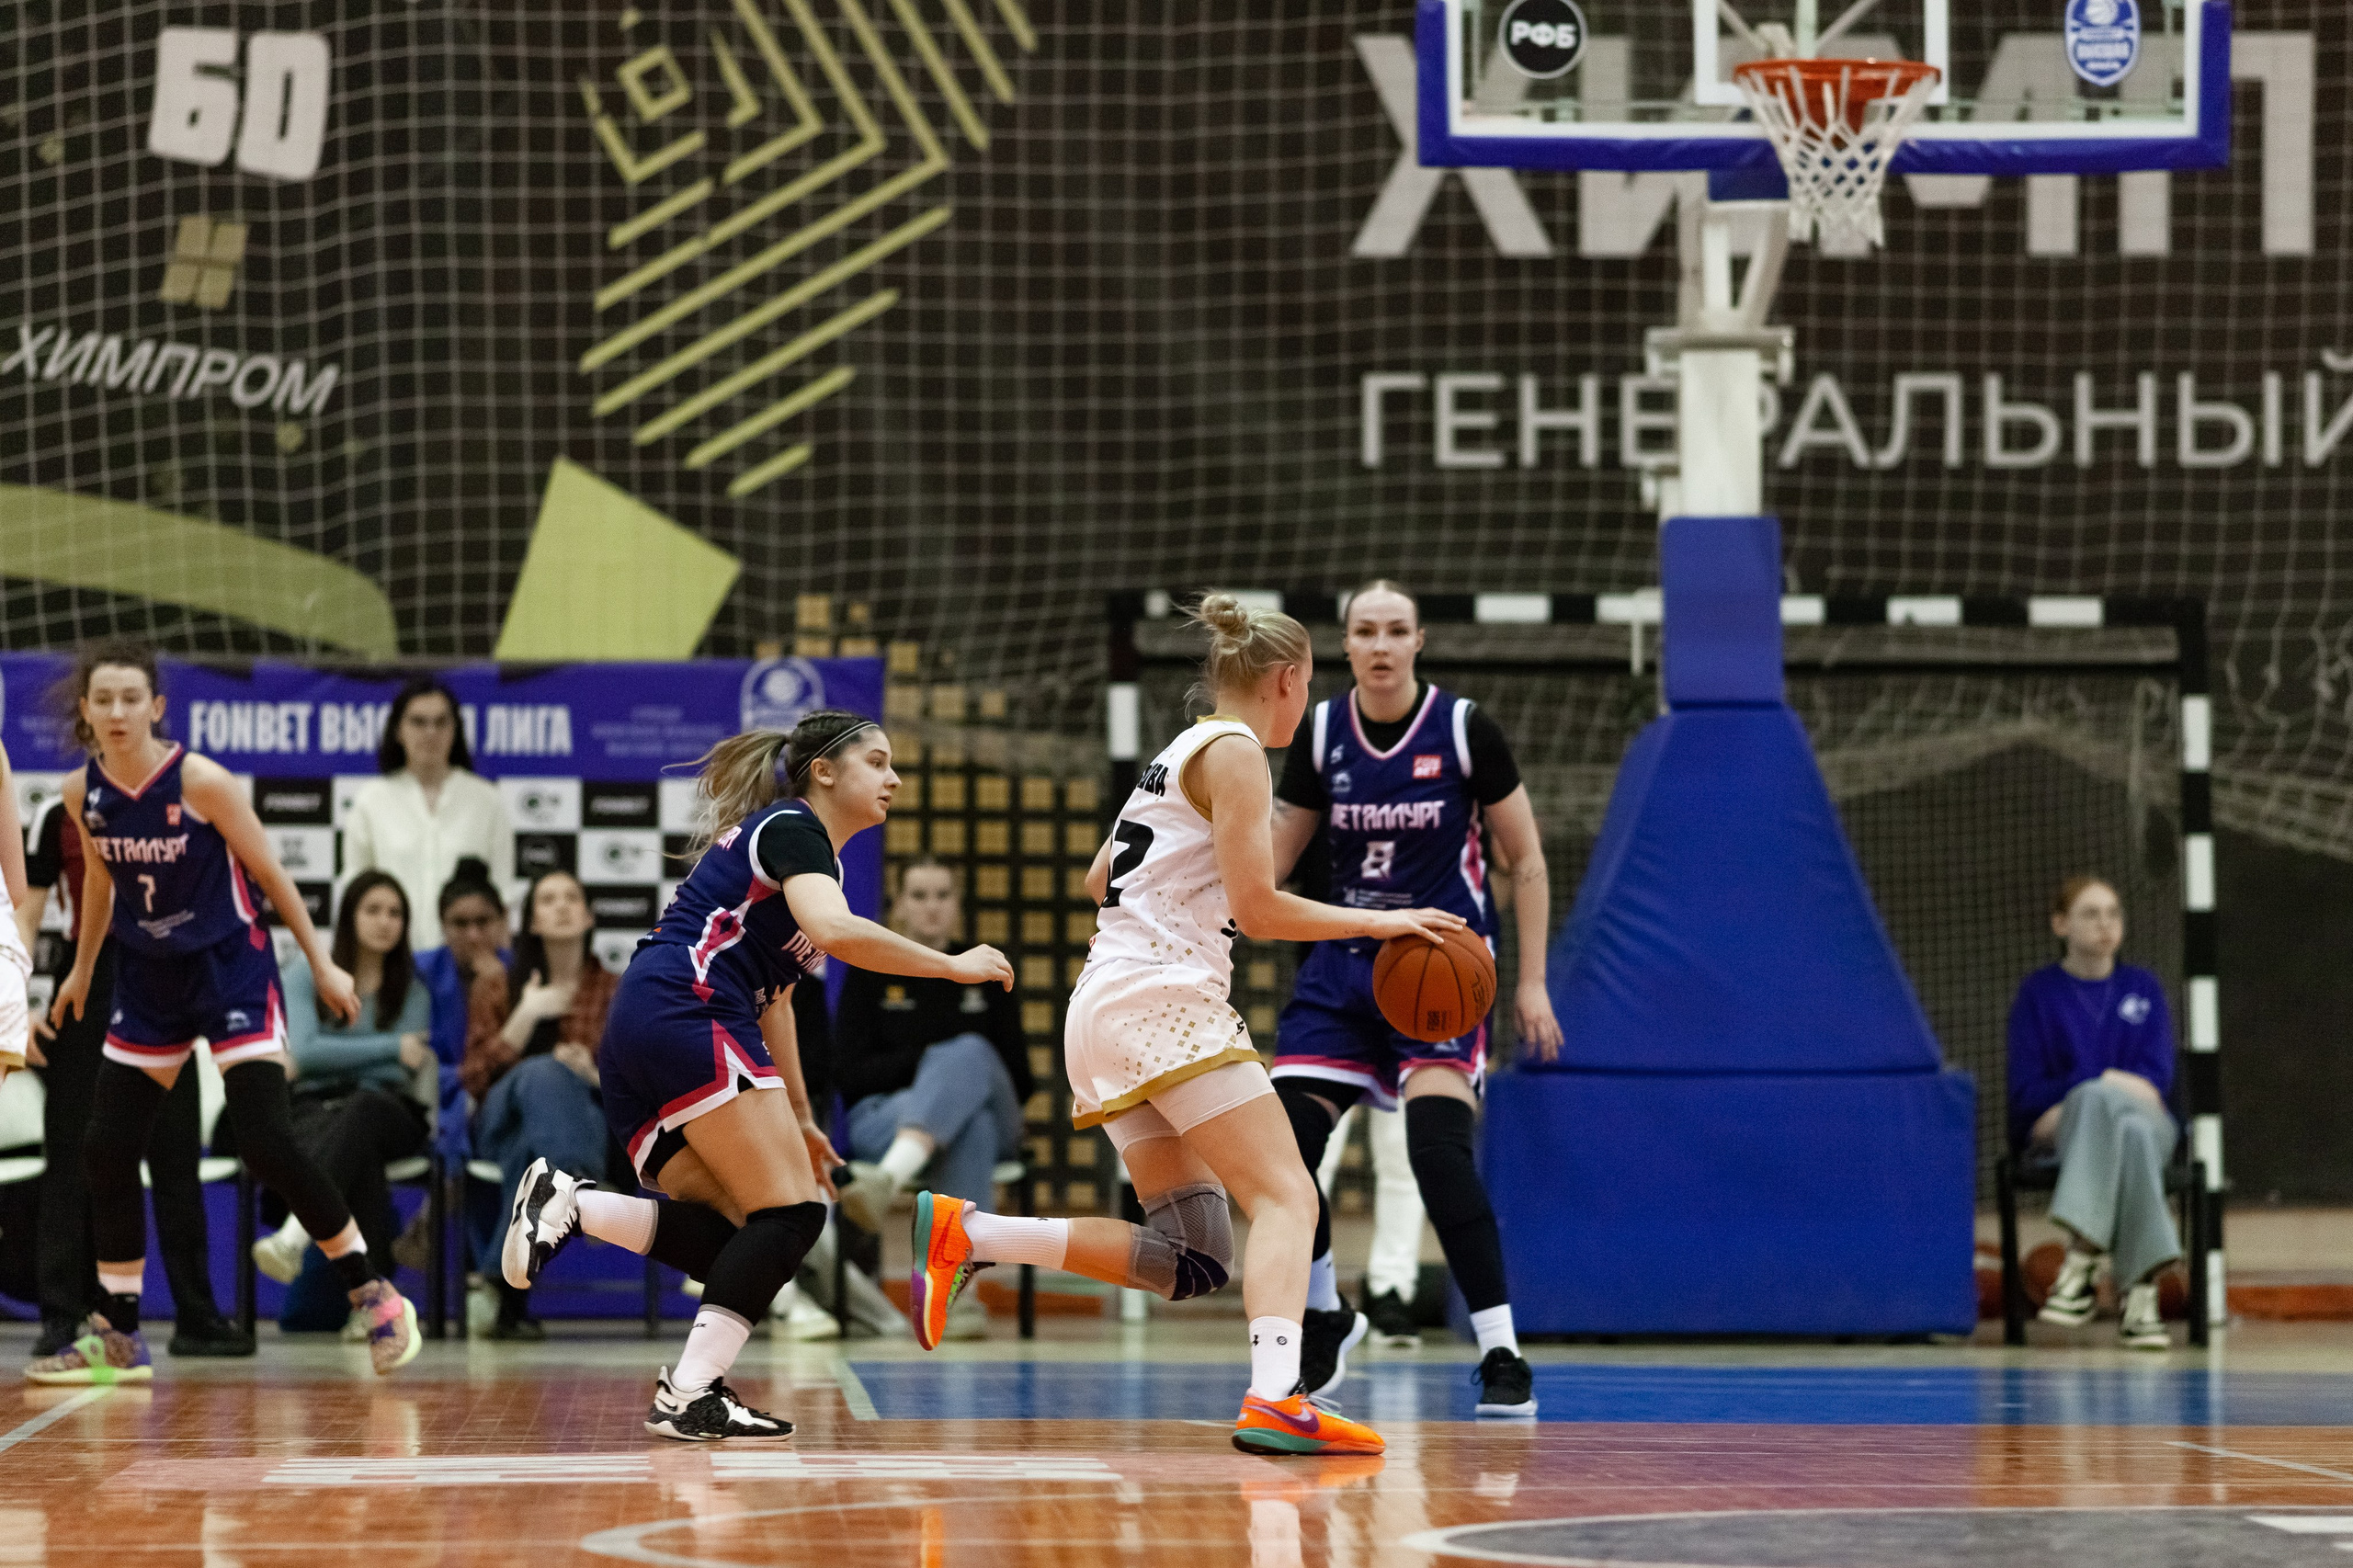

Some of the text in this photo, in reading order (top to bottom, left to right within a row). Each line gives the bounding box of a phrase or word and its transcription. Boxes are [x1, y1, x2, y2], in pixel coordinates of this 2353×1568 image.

[1510, 19, 1576, 49] РФБ
[2, 322, 341, 415] ХИМПРОМ
[188, 700, 313, 754] FONBET
[483, 702, 574, 758] ЛИГА
[1361, 840, 1395, 880] 8
[137, 873, 156, 914] 7
